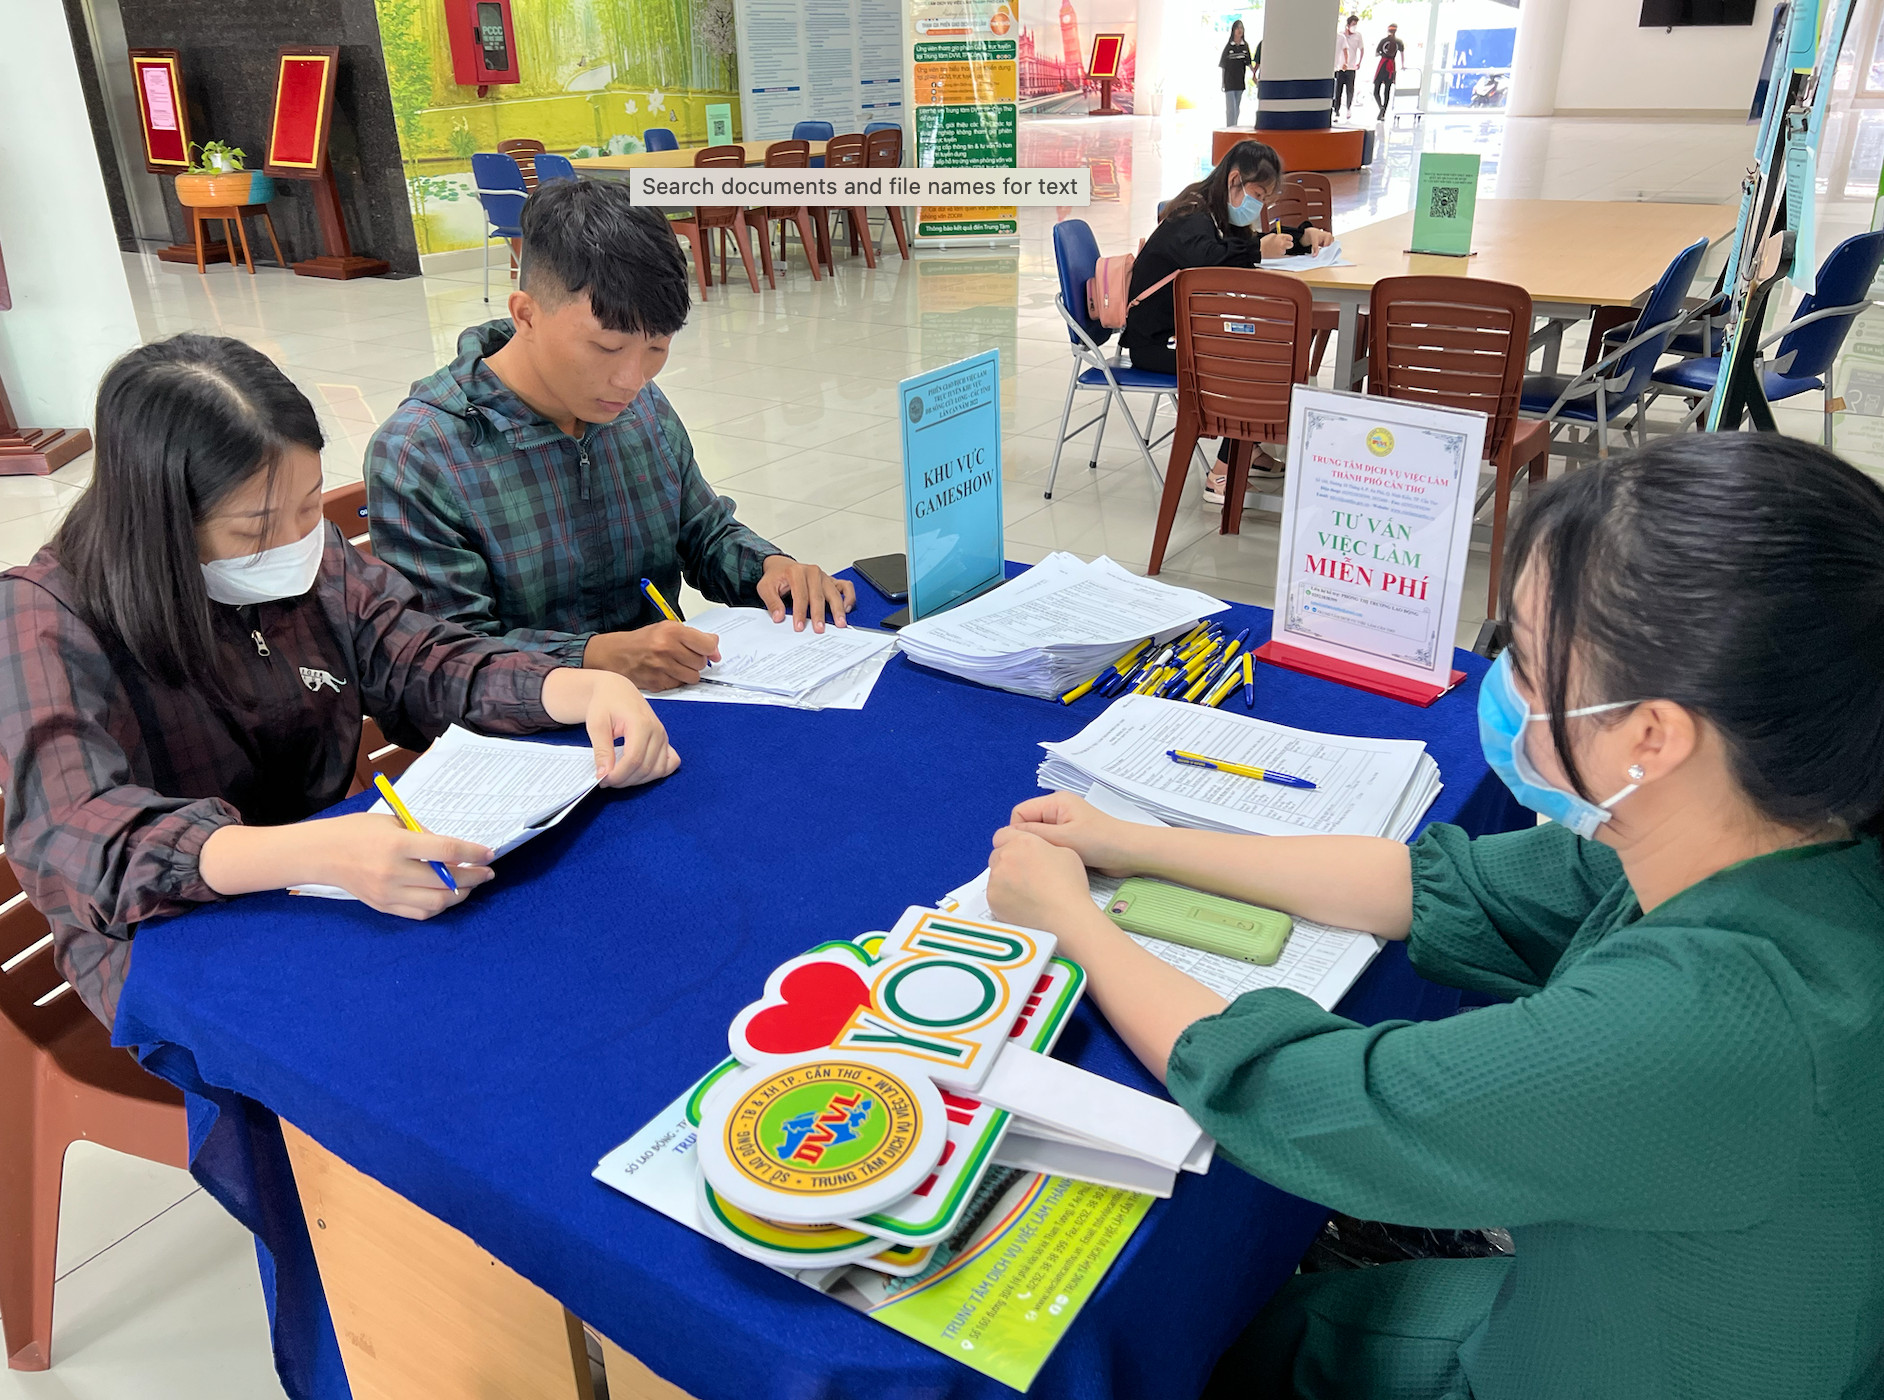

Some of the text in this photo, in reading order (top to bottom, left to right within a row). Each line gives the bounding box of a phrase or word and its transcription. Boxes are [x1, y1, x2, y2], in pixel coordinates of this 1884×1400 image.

[482, 26, 502, 35] PCCC
[924, 448, 985, 489] KHU VỰC
[1312, 454, 1449, 487] TRUNG TÂM DỊCH VỤ VIỆC LÀM
[915, 469, 994, 519] GAMESHOW
[1331, 470, 1425, 495] THÀNH PHỐ CẦN THƠ
[1332, 509, 1412, 541] TƯ VẤN
[1318, 531, 1423, 570] VIỆC LÀM
[1304, 554, 1431, 601] MIỄN PHÍ
[832, 914, 1036, 1067] YOU
[805, 1065, 831, 1080] CẦN
[837, 1068, 863, 1080] THƠ
[751, 1099, 764, 1107] &
[761, 1085, 780, 1099] XH
[741, 1107, 757, 1121] TB
[793, 1091, 864, 1166] DVVL
[810, 1080, 913, 1188] TRUNG TÂM DỊCH VỤ VIỆC LÀM
[736, 1131, 750, 1158] ĐỘNG
[625, 1163, 639, 1174] SỞ
[636, 1151, 654, 1164] LAO
[749, 1155, 771, 1175] LAO
[769, 1170, 790, 1184] SỞ
[941, 1303, 976, 1340] TRUNG
[969, 1279, 994, 1307] TÂM
[985, 1261, 1008, 1284] DỊCH
[1003, 1244, 1022, 1262] VỤ
[1016, 1224, 1039, 1247] VIỆC
[1030, 1203, 1053, 1227] LÀM
